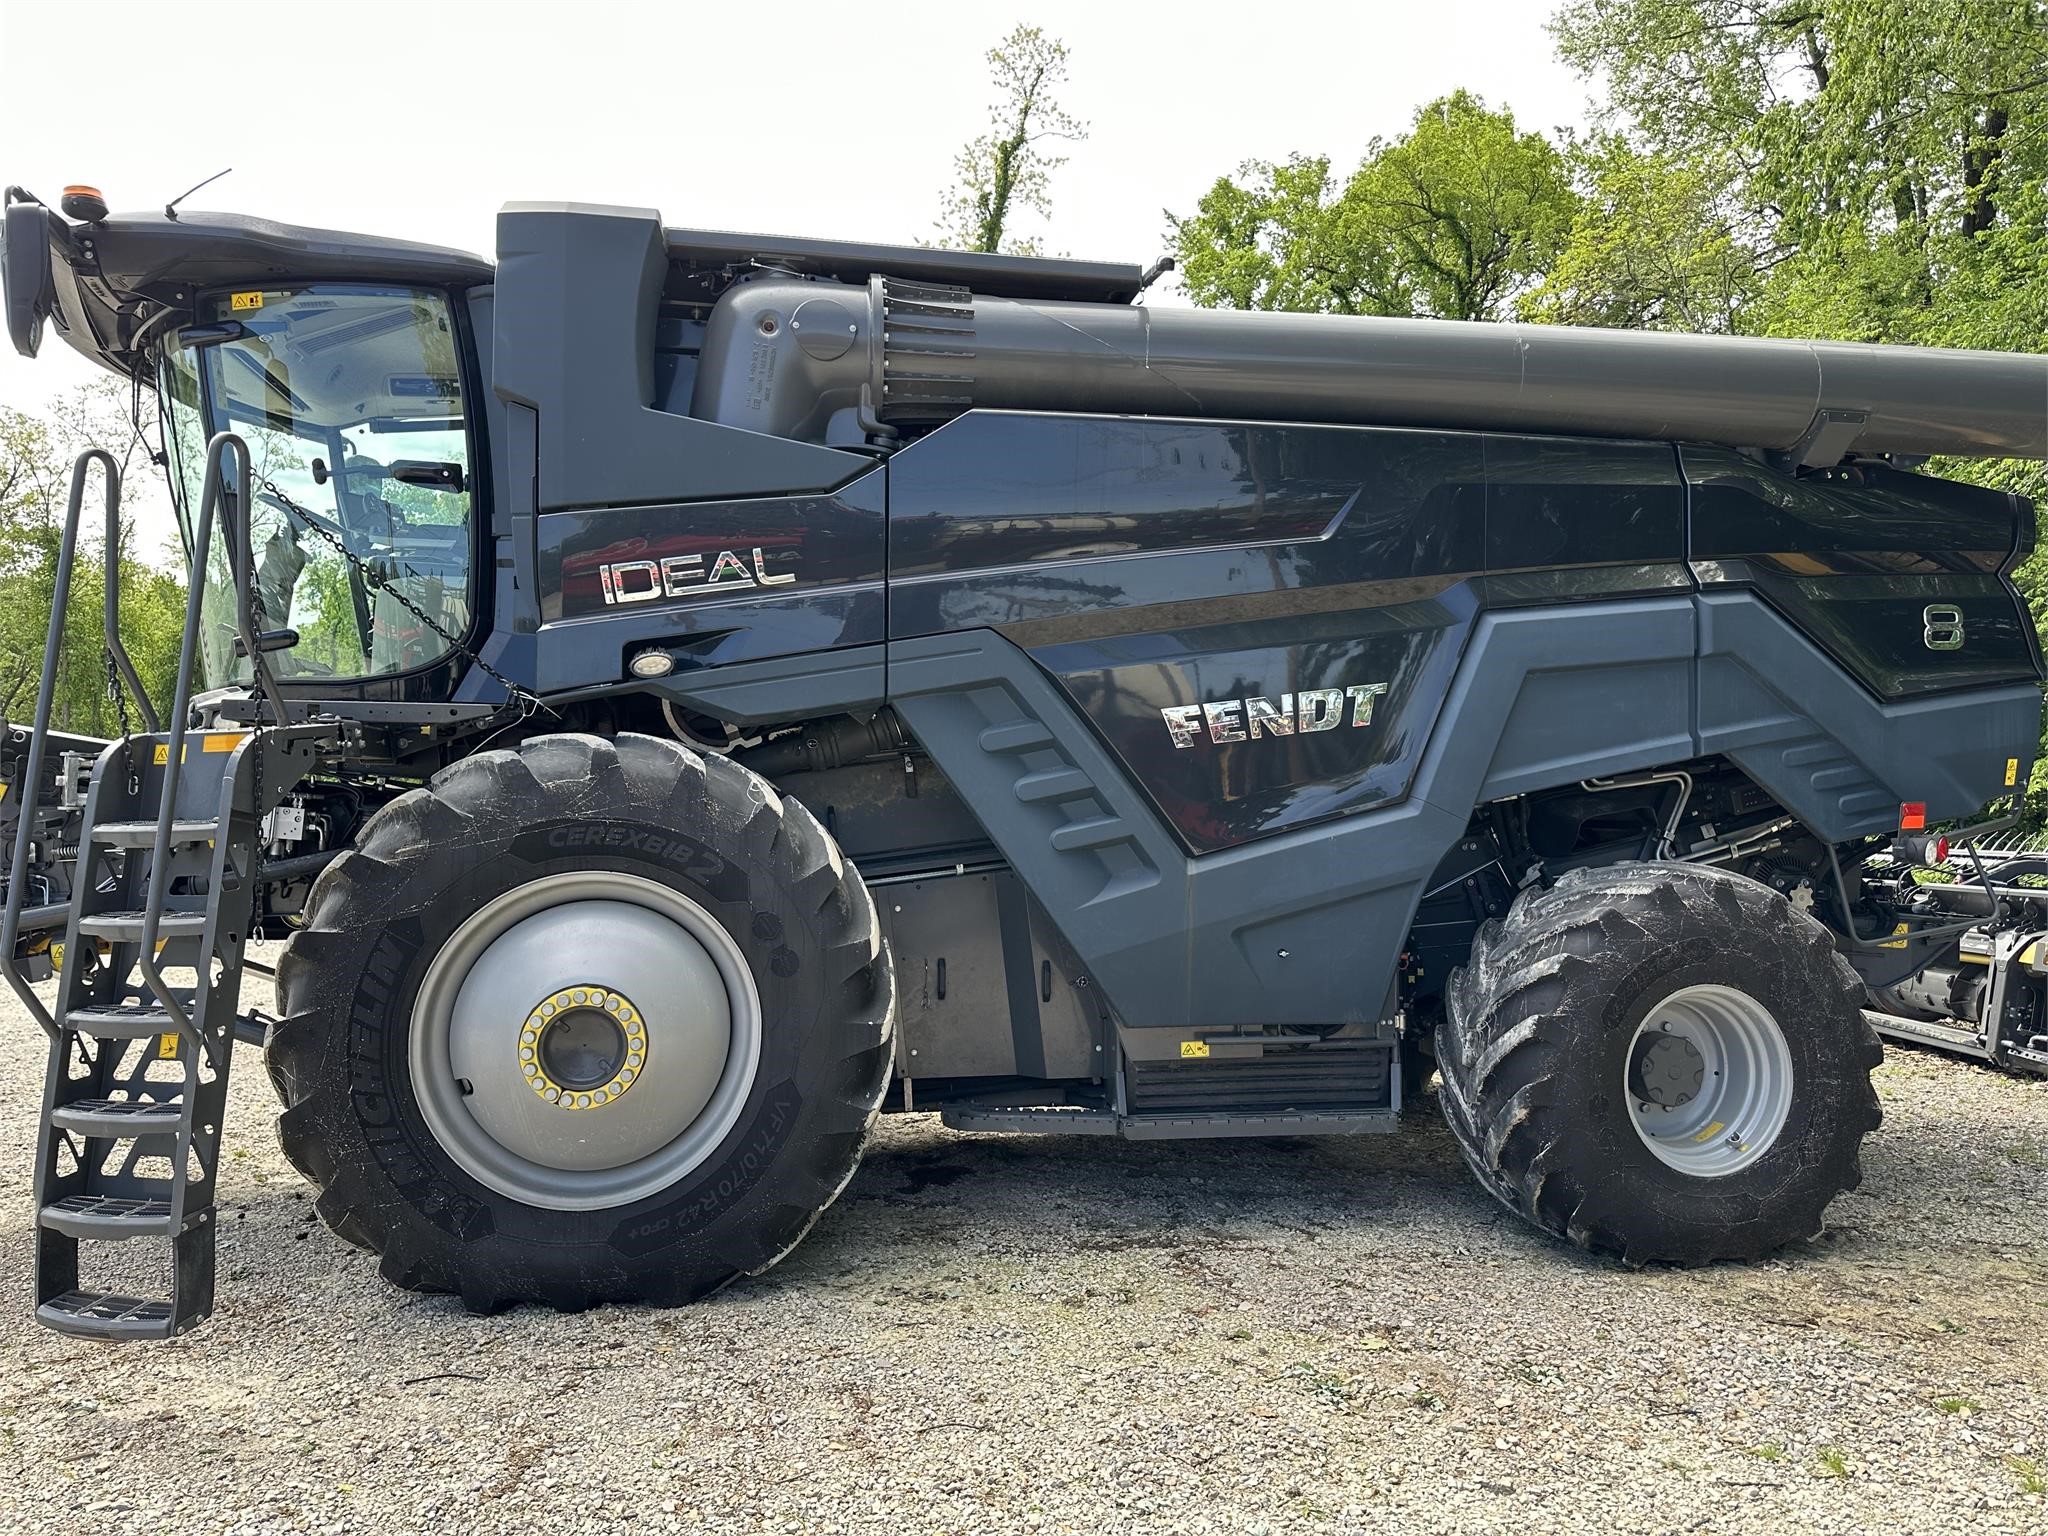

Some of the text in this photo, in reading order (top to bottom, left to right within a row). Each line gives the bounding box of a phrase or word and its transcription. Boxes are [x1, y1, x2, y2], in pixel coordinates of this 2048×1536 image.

[600, 548, 797, 604] IDEAL
[1923, 604, 1965, 651] 8
[1161, 683, 1388, 749] FENDT
[548, 825, 725, 888] CEREXBIB 2
[351, 932, 430, 1187] MICHELIN
